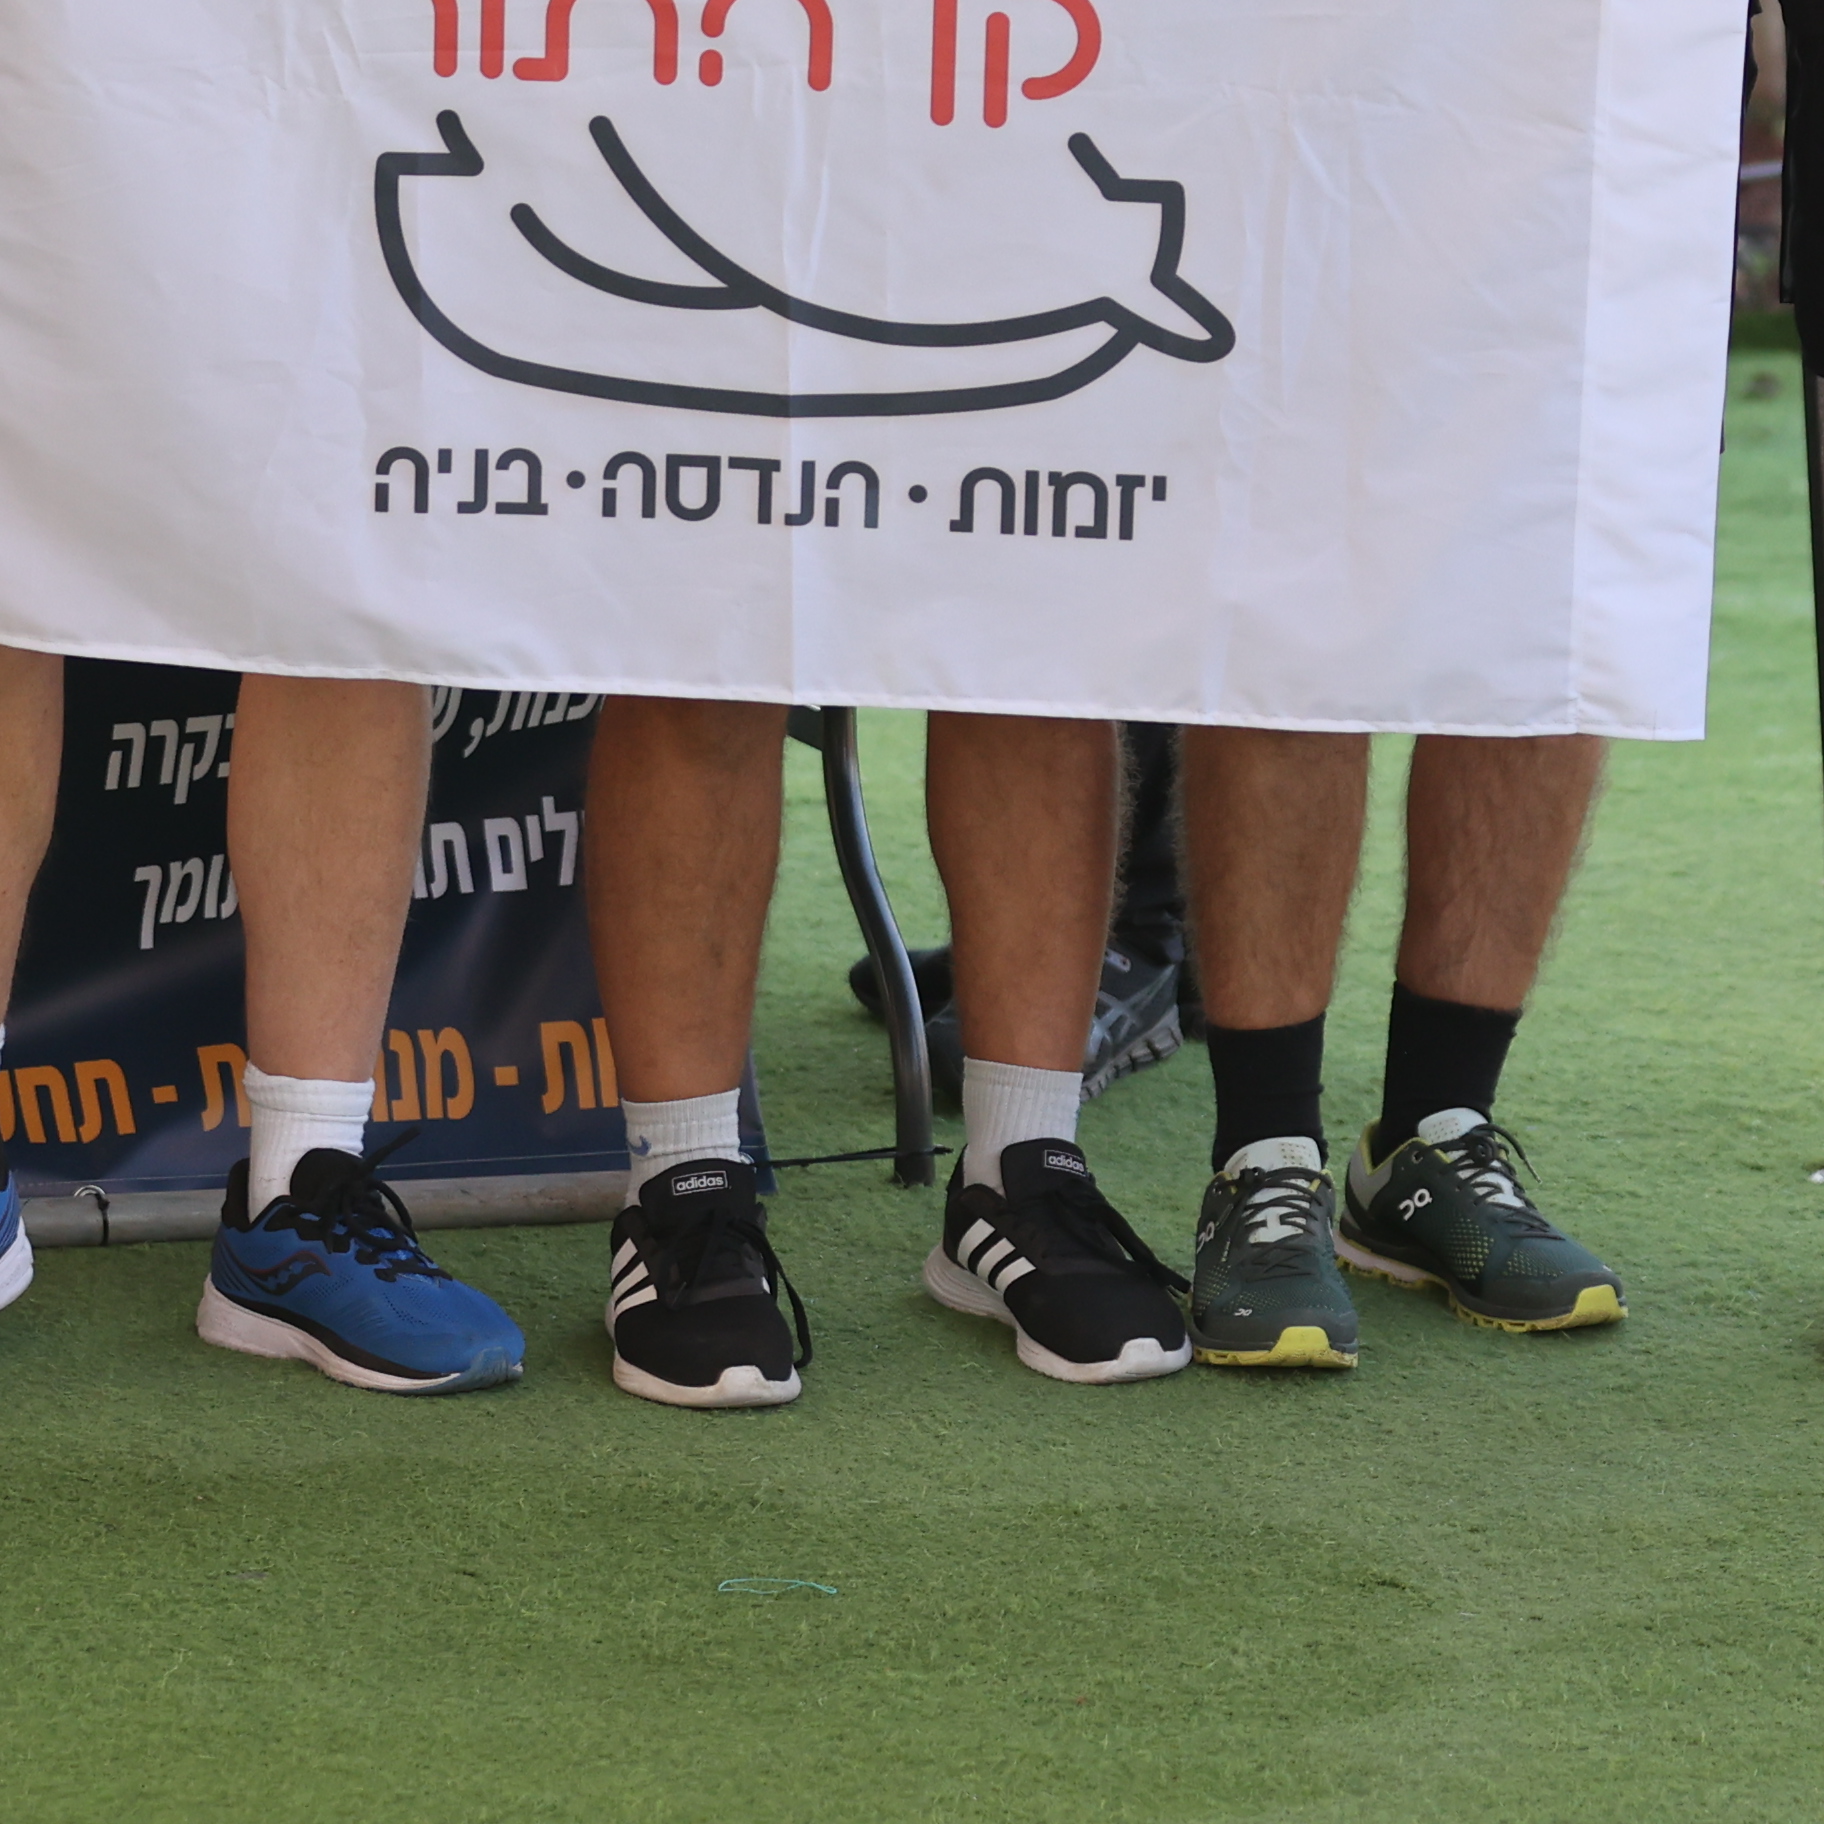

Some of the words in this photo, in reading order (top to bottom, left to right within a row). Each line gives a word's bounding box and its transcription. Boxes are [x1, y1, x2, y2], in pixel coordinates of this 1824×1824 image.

[372, 443, 550, 518] בניה
[600, 449, 880, 530] הנדסה
[949, 463, 1169, 542] יזמות
[675, 1172, 725, 1193] adidas
